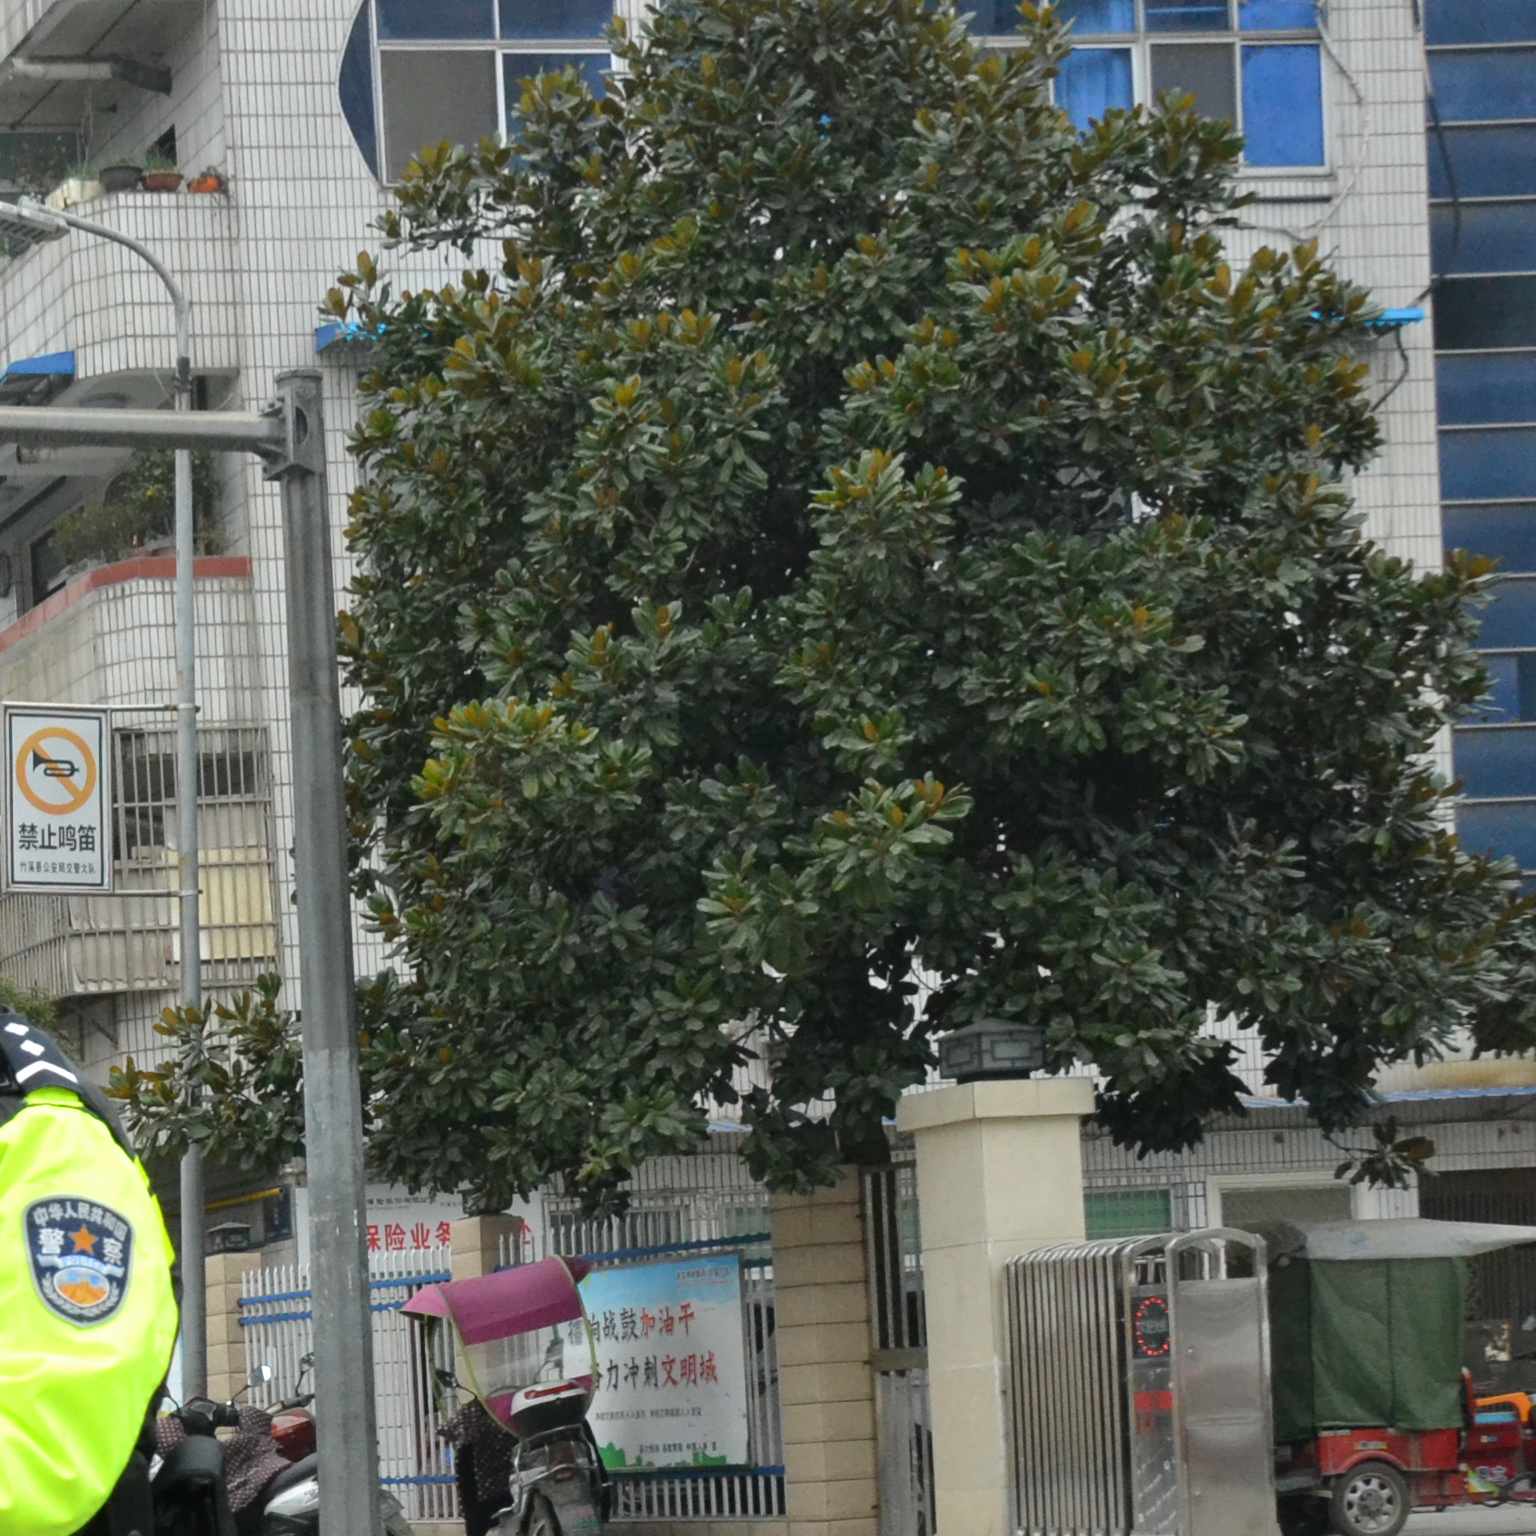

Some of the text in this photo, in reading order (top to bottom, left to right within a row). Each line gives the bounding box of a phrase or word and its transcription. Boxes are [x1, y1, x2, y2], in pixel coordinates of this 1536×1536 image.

[18, 822, 96, 852] 禁止鸣笛
[33, 1201, 128, 1242] 中华人民共和国
